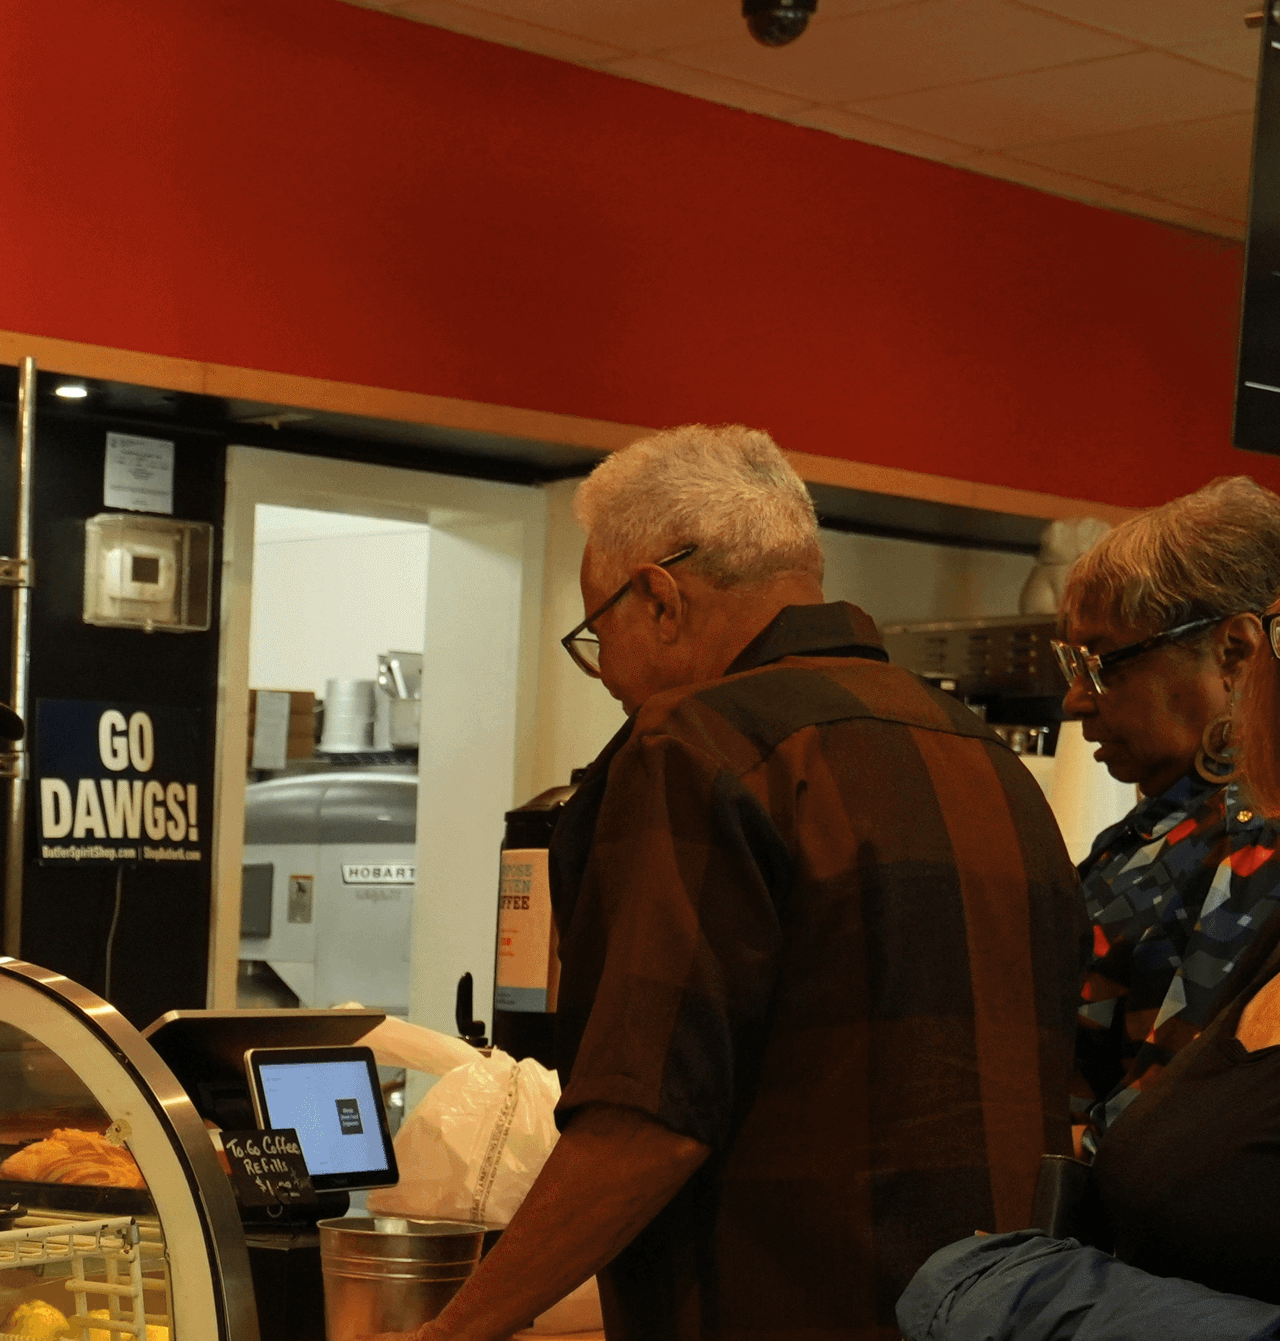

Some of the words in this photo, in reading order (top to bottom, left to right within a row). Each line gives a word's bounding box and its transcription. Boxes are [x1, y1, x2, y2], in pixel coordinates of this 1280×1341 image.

[98, 708, 155, 773] GO
[40, 777, 199, 842] DAWGS!
[348, 867, 415, 879] HOBART
[262, 1135, 301, 1155] Coffee
